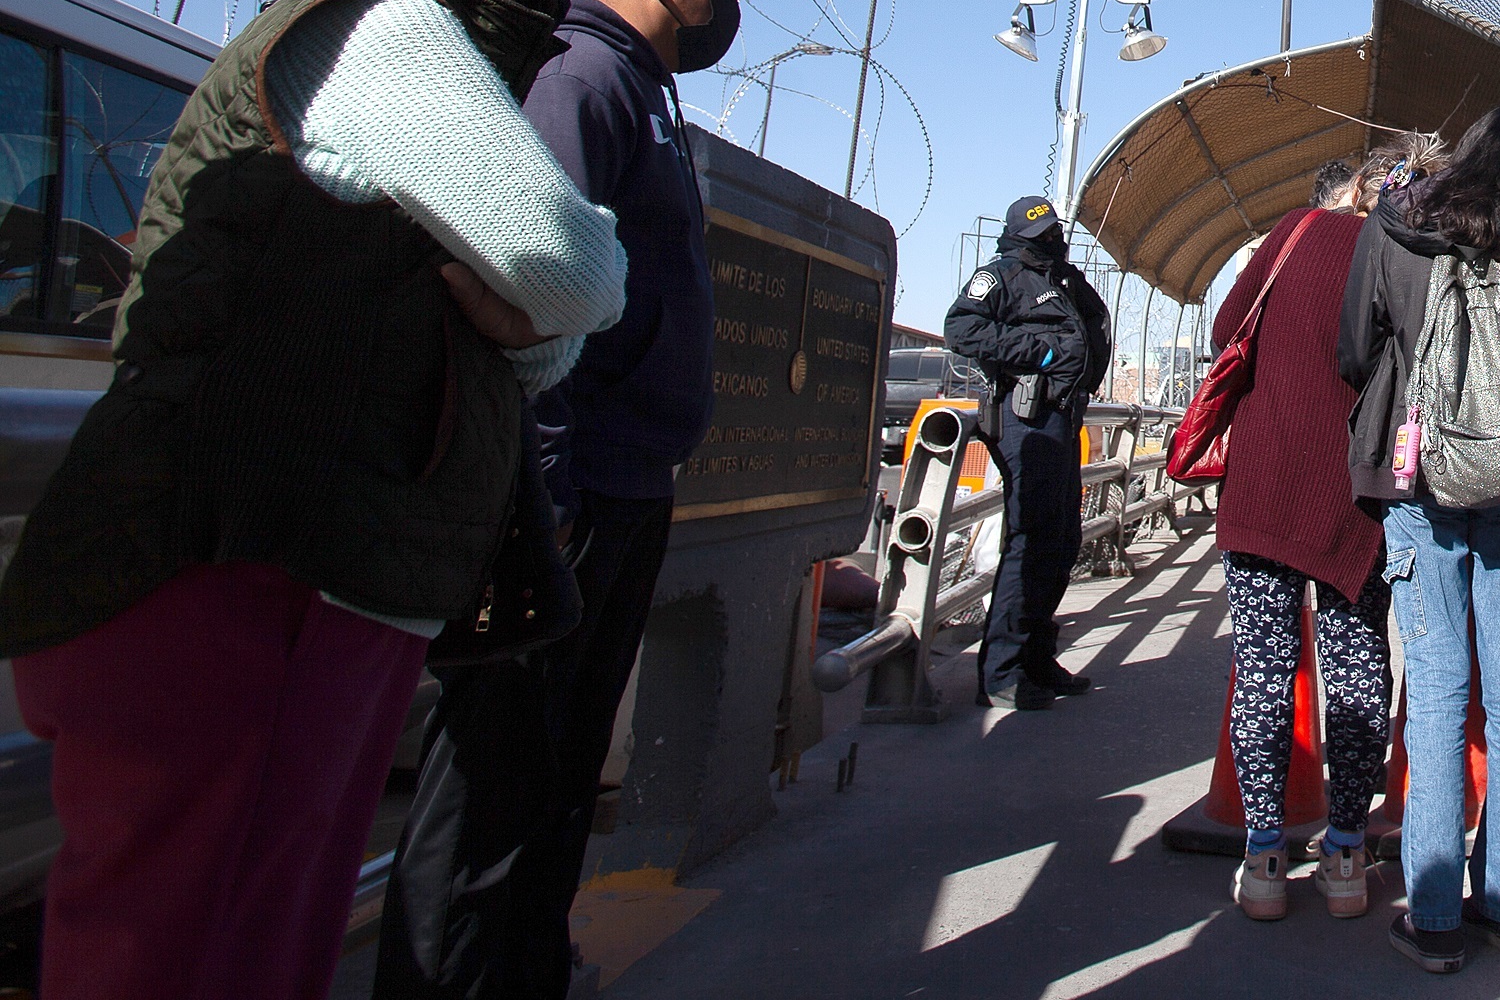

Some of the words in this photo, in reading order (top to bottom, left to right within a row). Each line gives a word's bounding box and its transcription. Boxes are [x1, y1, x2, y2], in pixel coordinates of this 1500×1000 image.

[1026, 204, 1050, 221] CBP
[711, 258, 746, 288] LIMITE
[748, 270, 763, 293] DE
[765, 275, 786, 298] LOS
[813, 288, 853, 315] BOUNDARY
[855, 302, 865, 319] OF
[866, 304, 879, 323] THE
[714, 317, 747, 344] ADOS
[750, 324, 788, 349] UNIDOS
[816, 337, 844, 360] UNITED
[845, 343, 870, 365] STATES
[712, 371, 769, 397] EXICANOS
[817, 383, 829, 402] OF
[830, 386, 860, 404] AMERICA
[724, 426, 788, 443] INTERNACIONAL
[687, 458, 700, 475] DE
[703, 456, 738, 474] LIMITES
[748, 454, 775, 472] AGUAS
